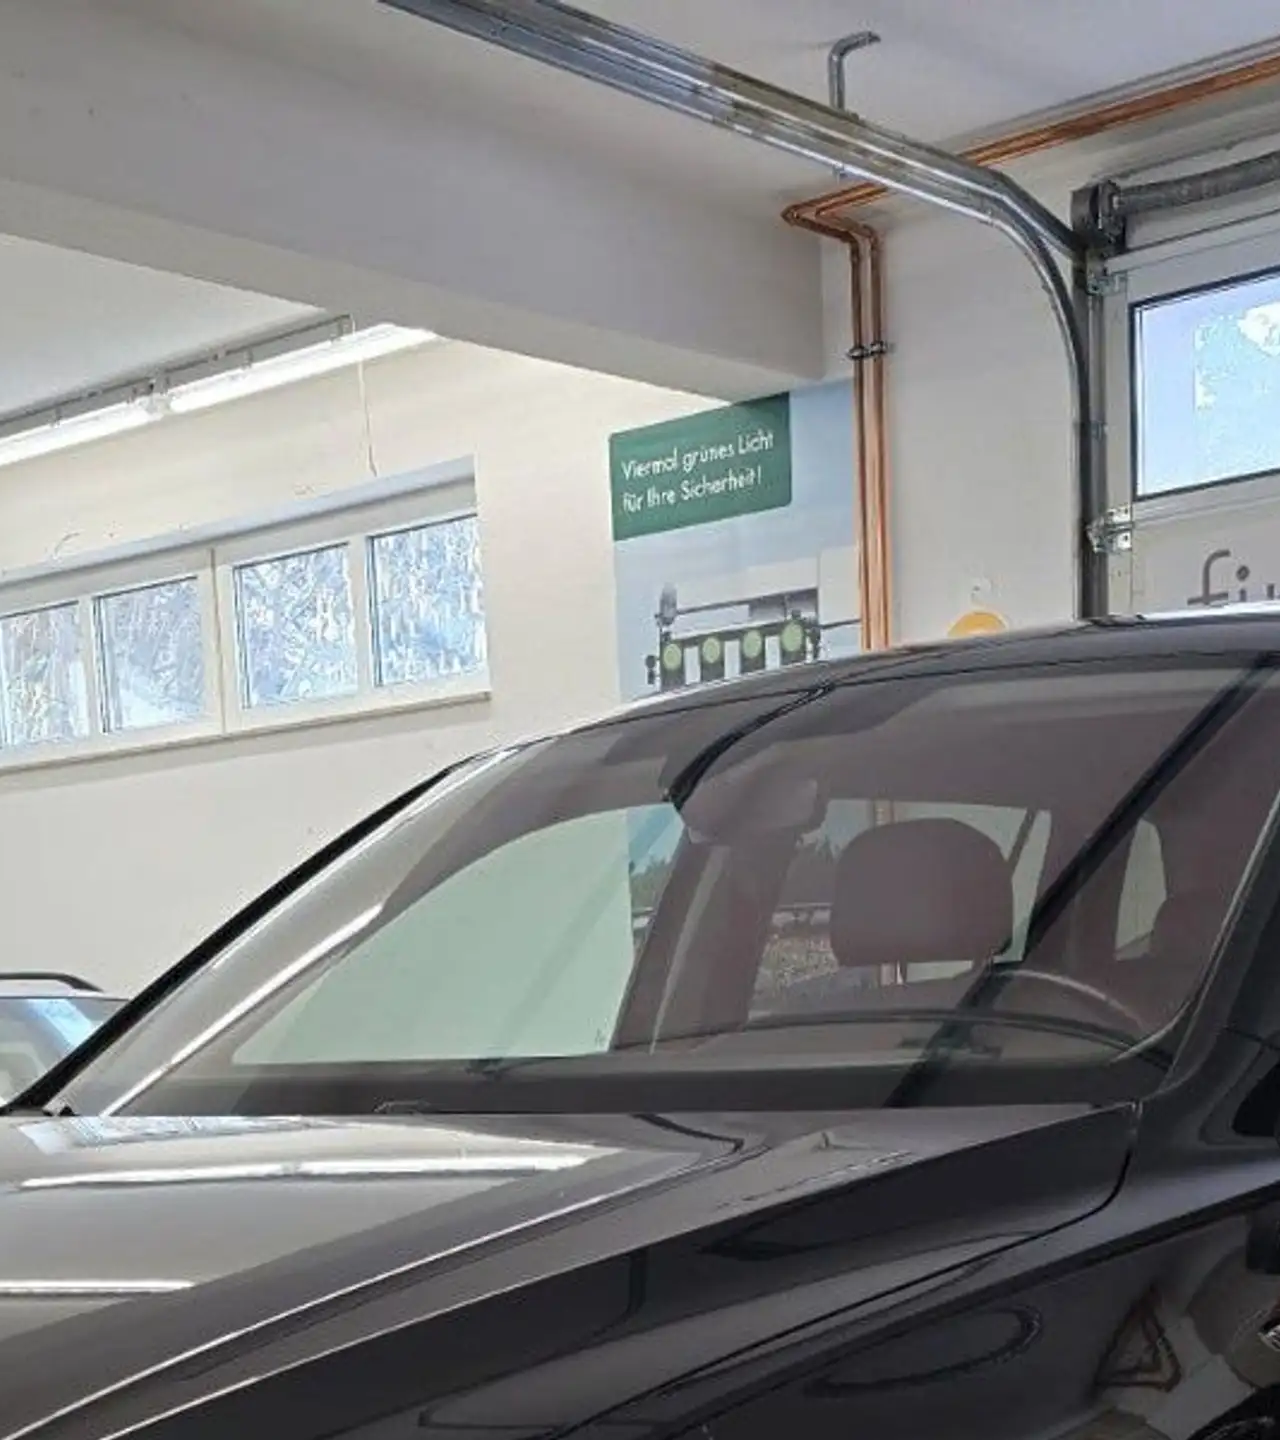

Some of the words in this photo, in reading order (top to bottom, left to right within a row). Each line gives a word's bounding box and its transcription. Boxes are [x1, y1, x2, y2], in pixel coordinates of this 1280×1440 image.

[621, 448, 678, 480] Viermal
[683, 444, 734, 473] grünes
[738, 429, 774, 454] Licht
[623, 492, 643, 512] für
[647, 486, 676, 508] Ihre
[681, 465, 761, 500] Sicherheit!
